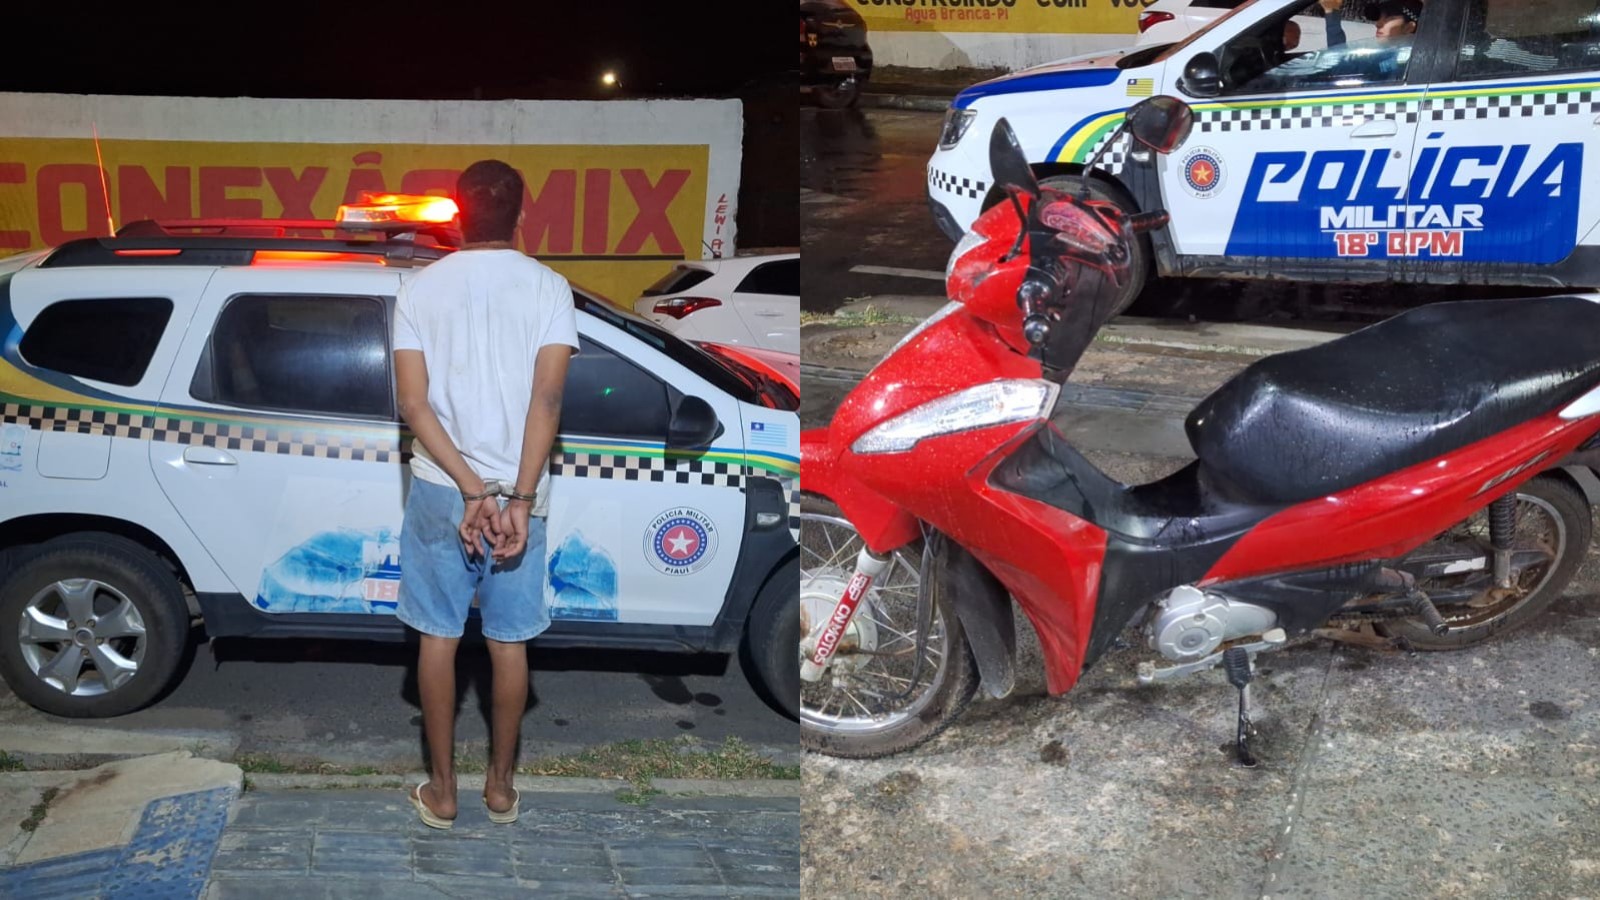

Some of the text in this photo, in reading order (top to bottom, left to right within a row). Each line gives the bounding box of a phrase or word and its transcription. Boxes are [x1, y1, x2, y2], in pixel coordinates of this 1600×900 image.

[1242, 132, 1583, 202] POLÍCIA
[512, 168, 691, 254] MIX
[1320, 204, 1484, 229] MILITAR
[1387, 231, 1463, 256] BPM
[686, 510, 714, 533] MILITAR
